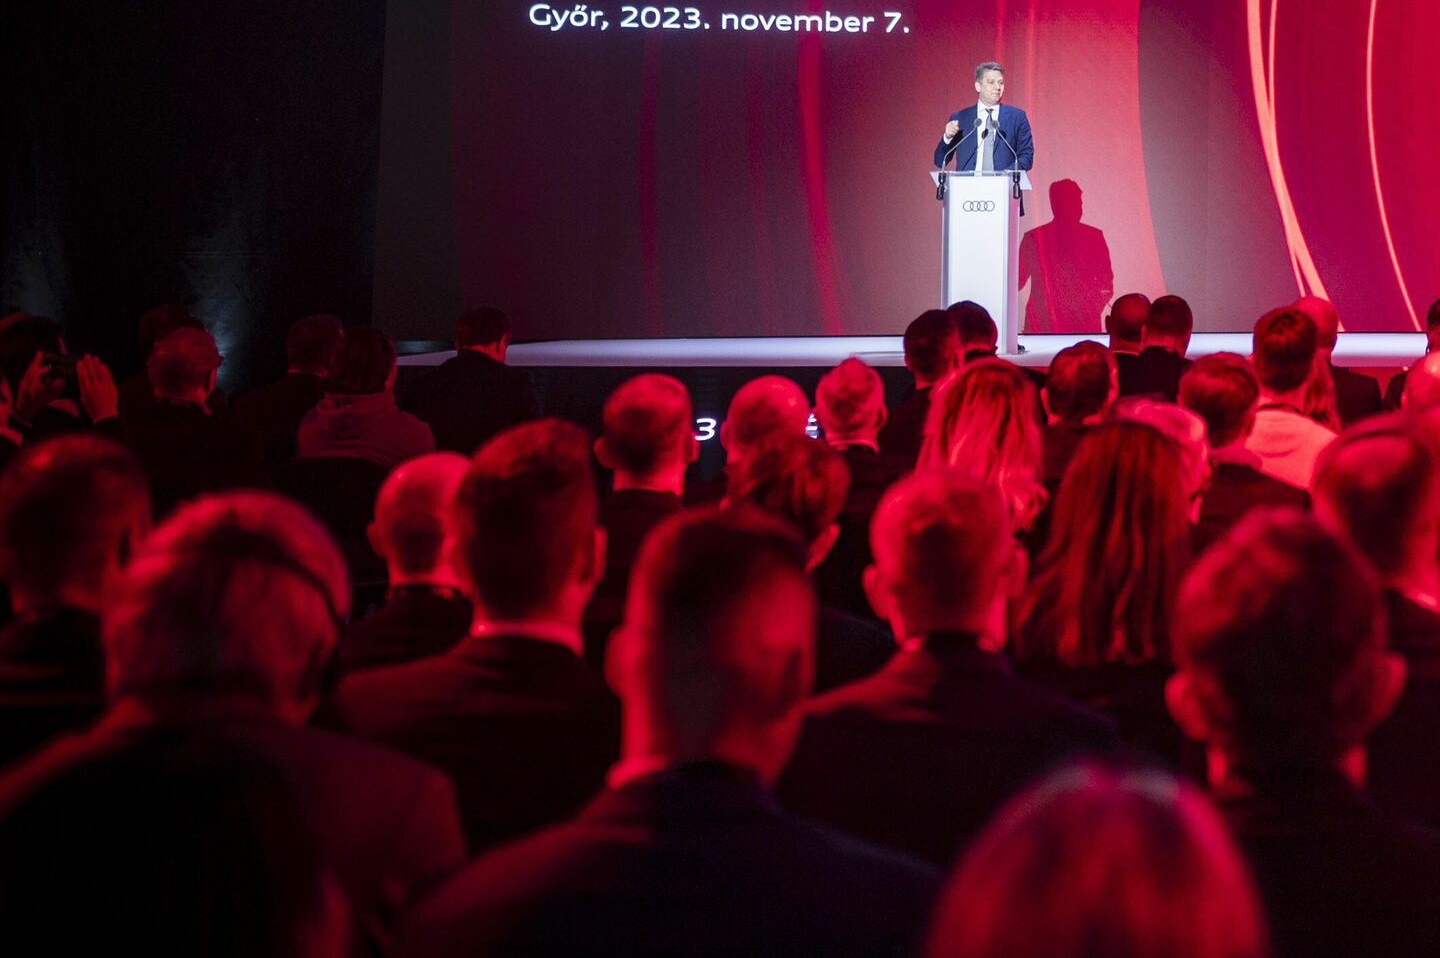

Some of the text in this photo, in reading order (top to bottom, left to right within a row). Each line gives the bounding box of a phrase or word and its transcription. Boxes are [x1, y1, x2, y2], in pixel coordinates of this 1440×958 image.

[528, 3, 910, 34] Győr, 2023. november 7.
